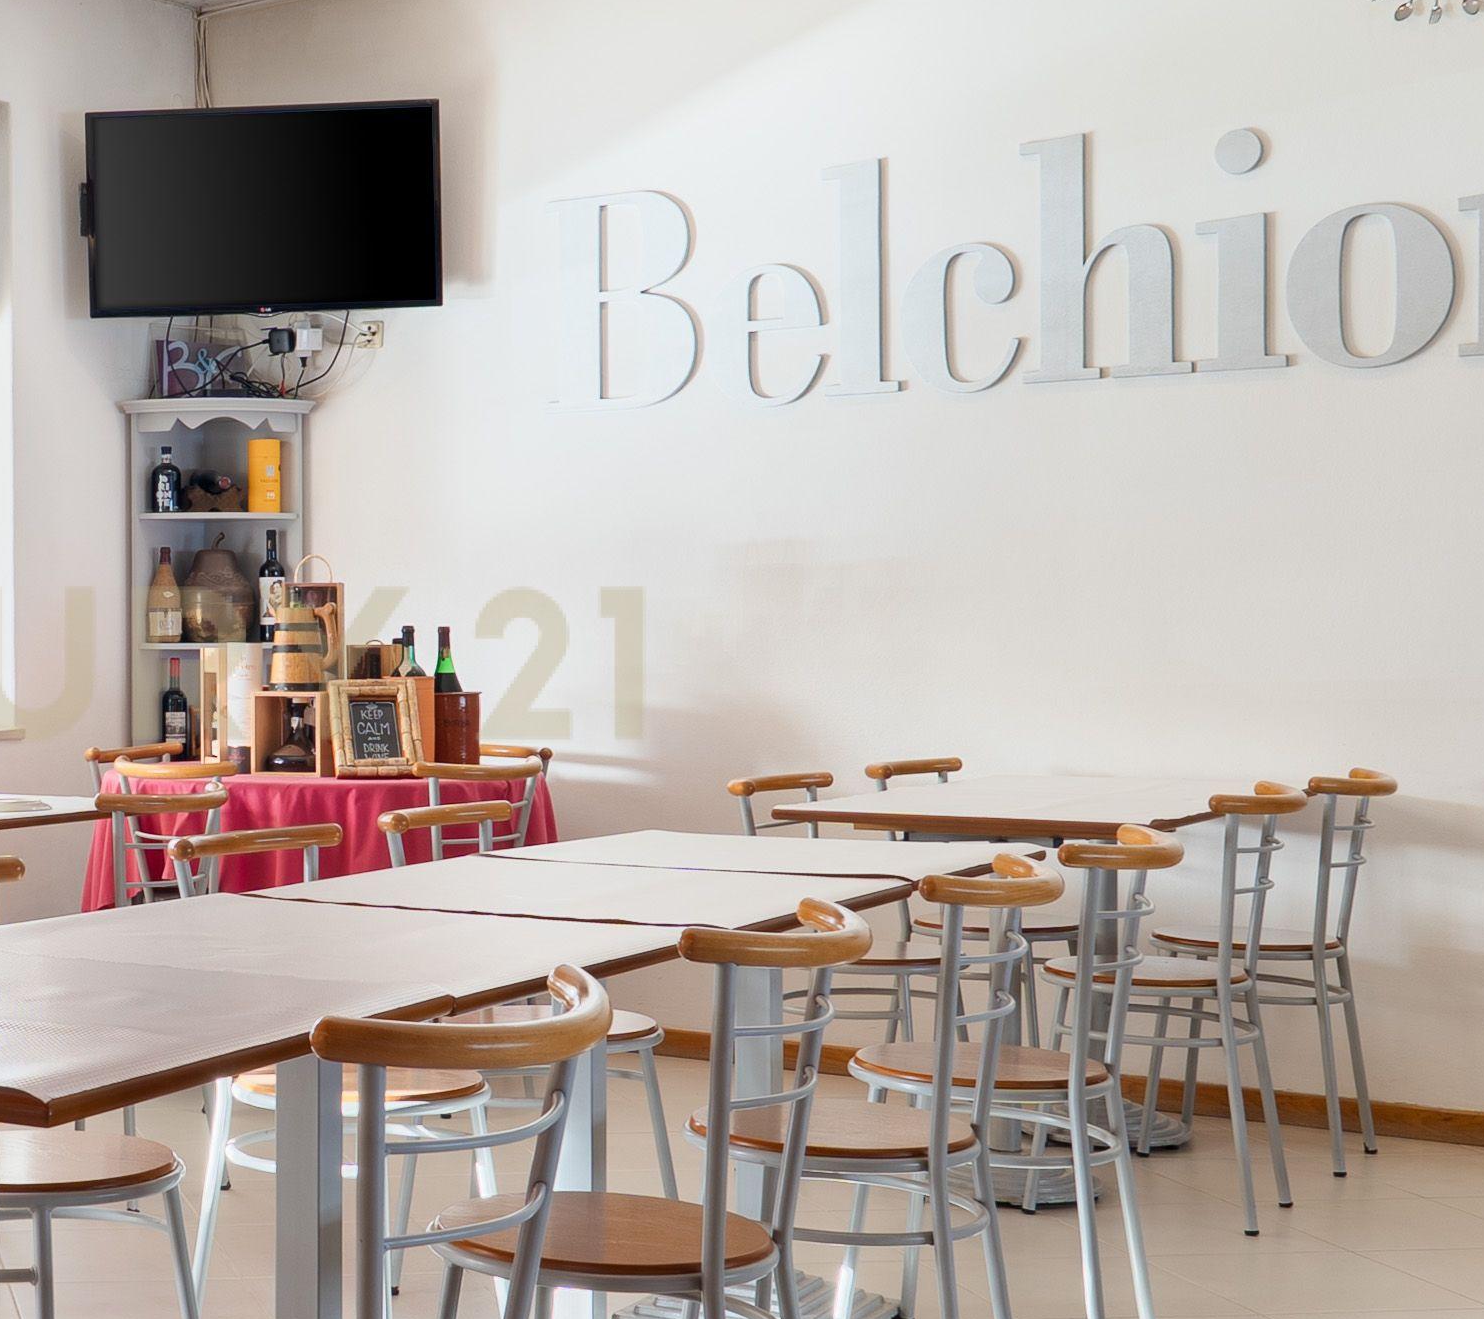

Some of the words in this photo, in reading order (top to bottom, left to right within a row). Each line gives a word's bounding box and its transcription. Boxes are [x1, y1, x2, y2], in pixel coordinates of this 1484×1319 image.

[360, 709, 384, 719] KEEP
[356, 722, 391, 735] CALM
[363, 742, 390, 753] DRINK
